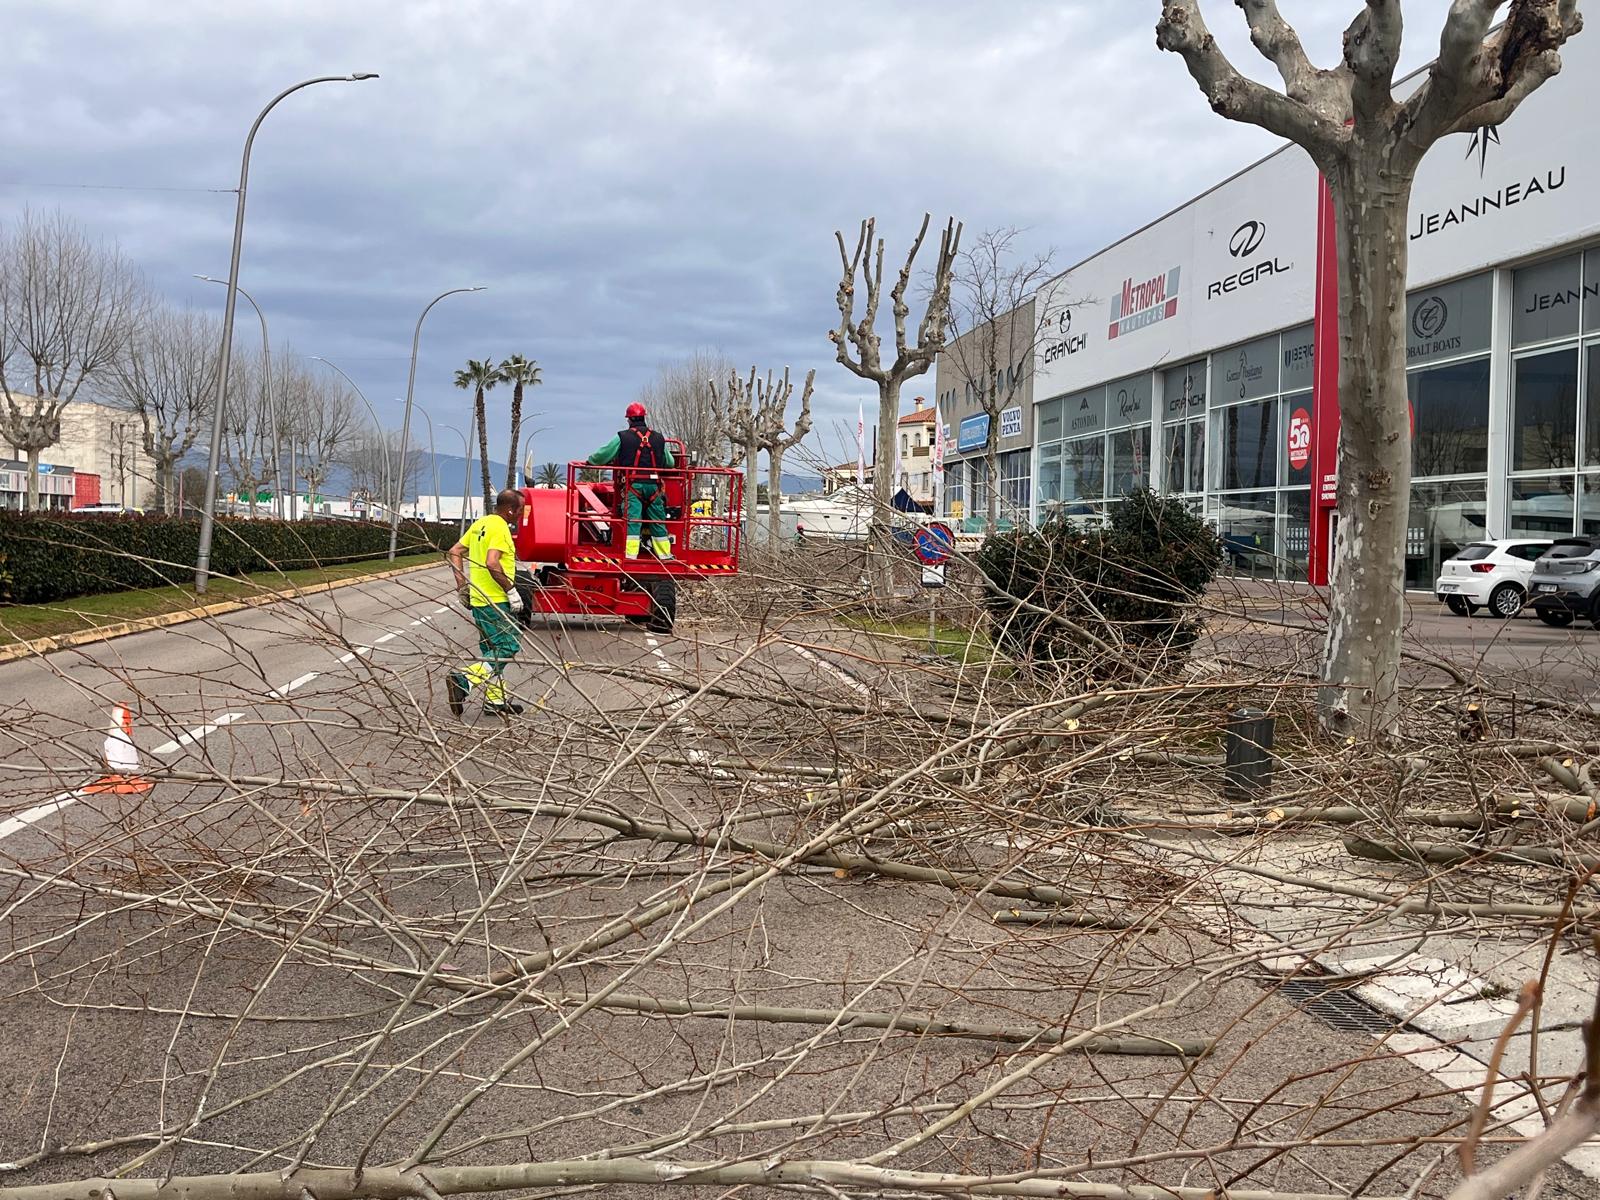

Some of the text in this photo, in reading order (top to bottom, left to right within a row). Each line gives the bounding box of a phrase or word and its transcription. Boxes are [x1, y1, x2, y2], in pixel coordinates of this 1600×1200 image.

[1410, 166, 1565, 240] JEANNEAU
[1208, 257, 1290, 300] REGAL
[1044, 333, 1087, 364] CRANCHI
[1406, 336, 1461, 359] OBALT BOATS
[1002, 409, 1021, 423] VOLVO
[1071, 415, 1098, 431] ASTONDOA
[1002, 422, 1021, 436] PENTA
